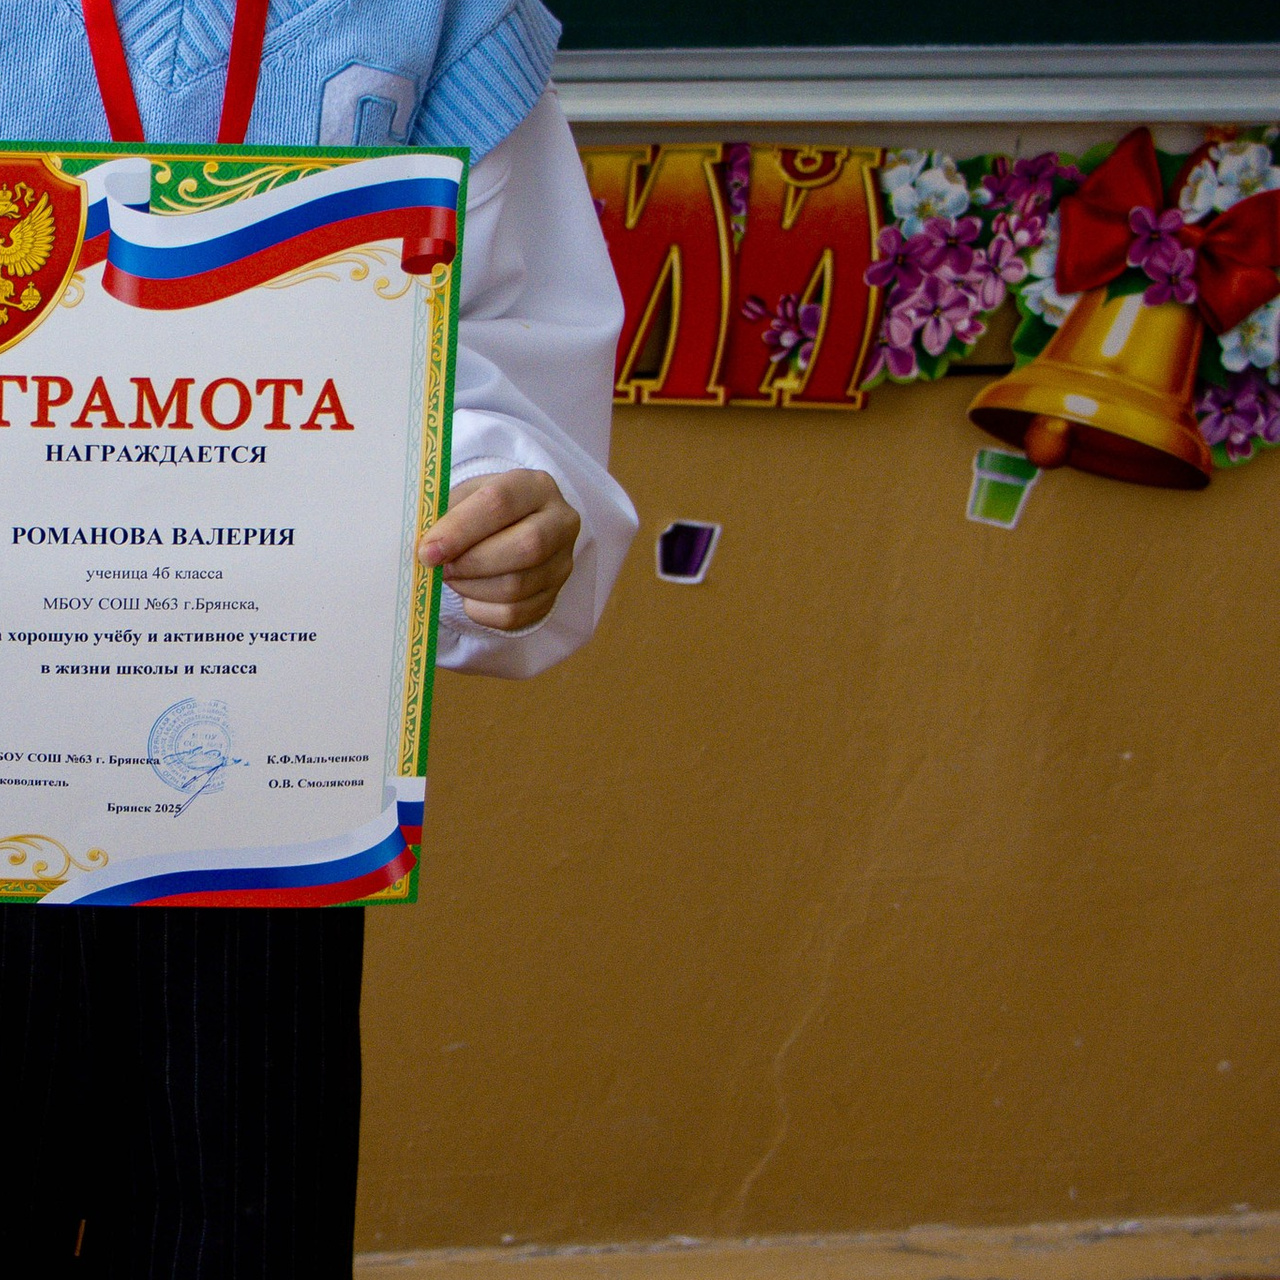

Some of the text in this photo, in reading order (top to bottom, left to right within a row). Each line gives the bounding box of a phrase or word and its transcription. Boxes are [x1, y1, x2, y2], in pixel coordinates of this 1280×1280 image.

[45, 444, 267, 467] НАГРАЖДАЕТСЯ
[12, 526, 295, 546] РОМАНОВА ВАЛЕРИЯ
[85, 566, 223, 583] ученица 4б класса
[43, 597, 259, 614] МБОУ СОШ №63 г.Брянска,
[8, 631, 89, 646] хорошую
[93, 629, 142, 647] учёбу
[147, 632, 158, 643] и
[163, 632, 245, 643] активное
[248, 631, 317, 646] участие
[40, 664, 257, 675] в жизни школы и класса
[27, 752, 62, 763] СОШ
[64, 754, 93, 764] №63
[95, 757, 106, 765] г.
[108, 754, 161, 767] Брянска
[268, 778, 364, 789] О.В. Смолякова
[107, 802, 182, 815] Брянск 2025
